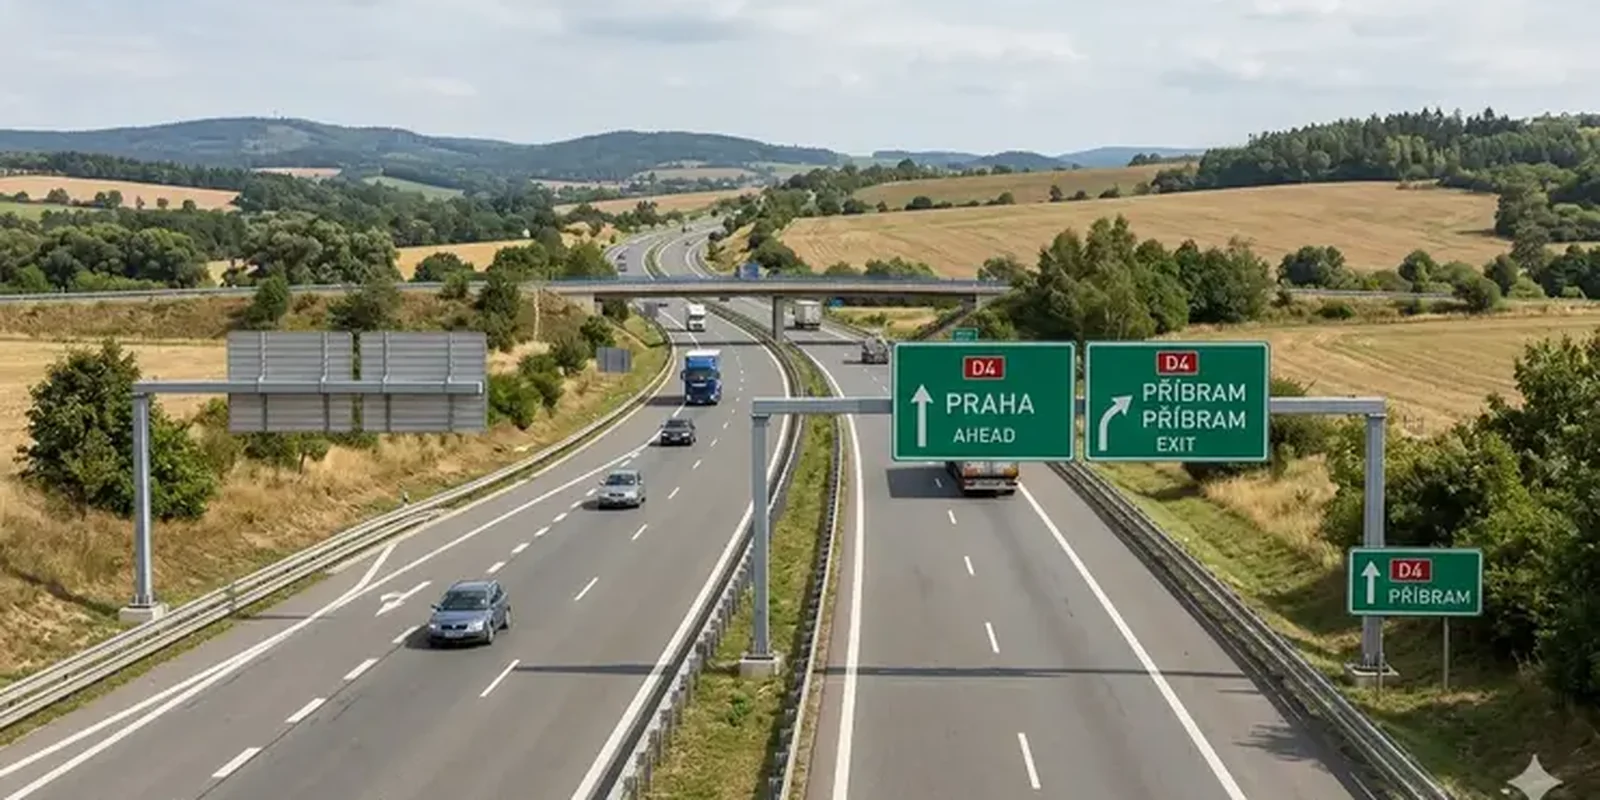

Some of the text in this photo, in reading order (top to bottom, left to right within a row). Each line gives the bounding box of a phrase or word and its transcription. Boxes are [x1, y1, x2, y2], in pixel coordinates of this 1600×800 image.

[972, 360, 996, 376] D4
[1166, 355, 1190, 371] D4
[1142, 379, 1246, 402] PŘÍBRAM
[946, 393, 1035, 415] PRAHA
[1142, 407, 1246, 430] PŘÍBRAM
[953, 427, 1016, 444] AHEAD
[1157, 436, 1196, 452] EXIT
[1398, 562, 1423, 578] D4
